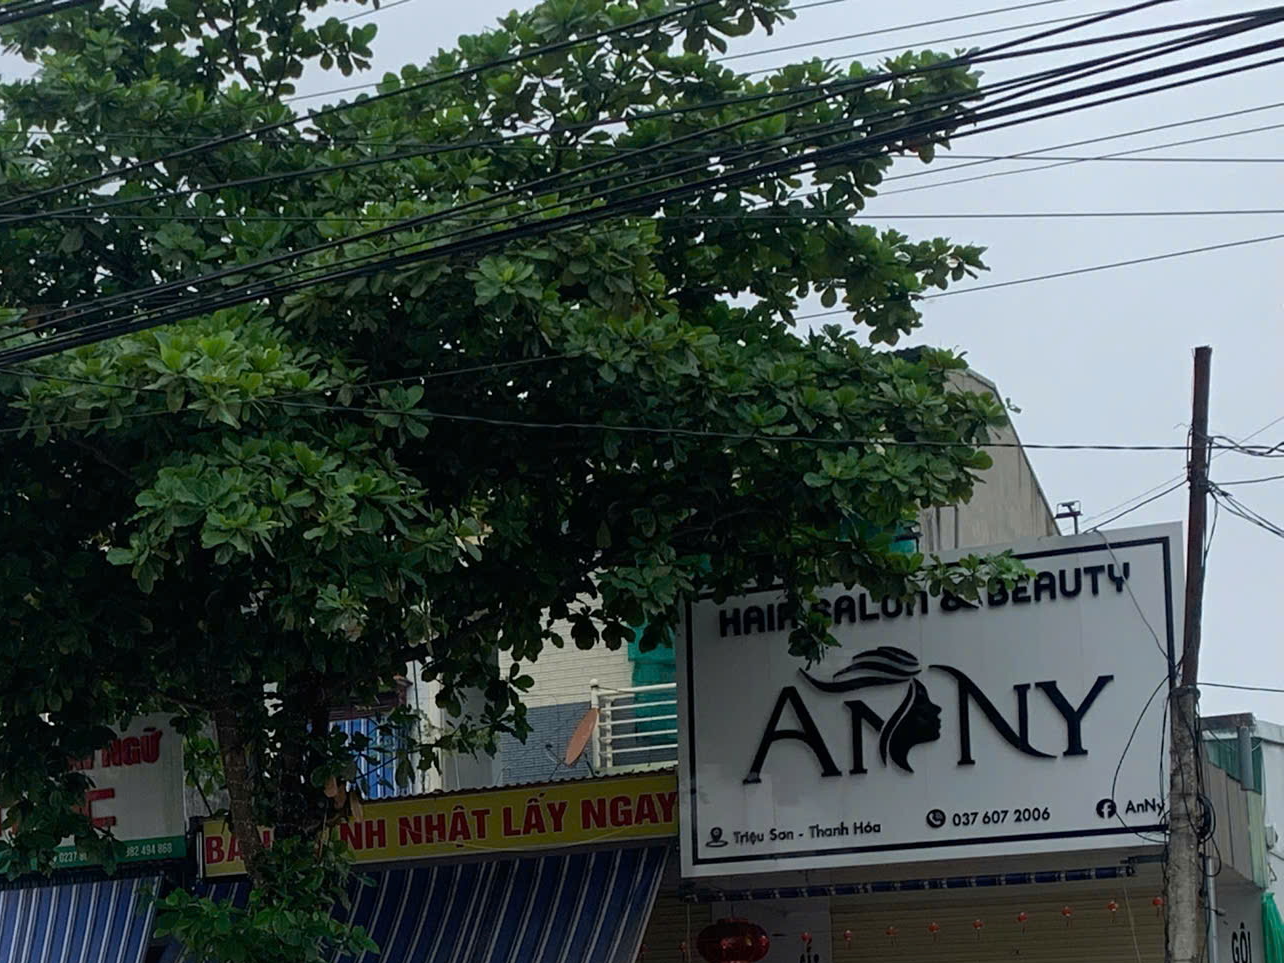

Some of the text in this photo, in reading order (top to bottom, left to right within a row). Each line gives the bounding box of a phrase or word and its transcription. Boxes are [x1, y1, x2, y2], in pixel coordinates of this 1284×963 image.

[987, 562, 1130, 606] BEAUTY
[399, 805, 490, 849] NHẬT
[502, 793, 568, 837] LẤY
[581, 791, 678, 830] NGAY
[733, 829, 765, 845] Triệu
[809, 822, 849, 838] Thanh
[853, 820, 882, 835] Hóa
[952, 807, 1051, 827] 037 607 2006
